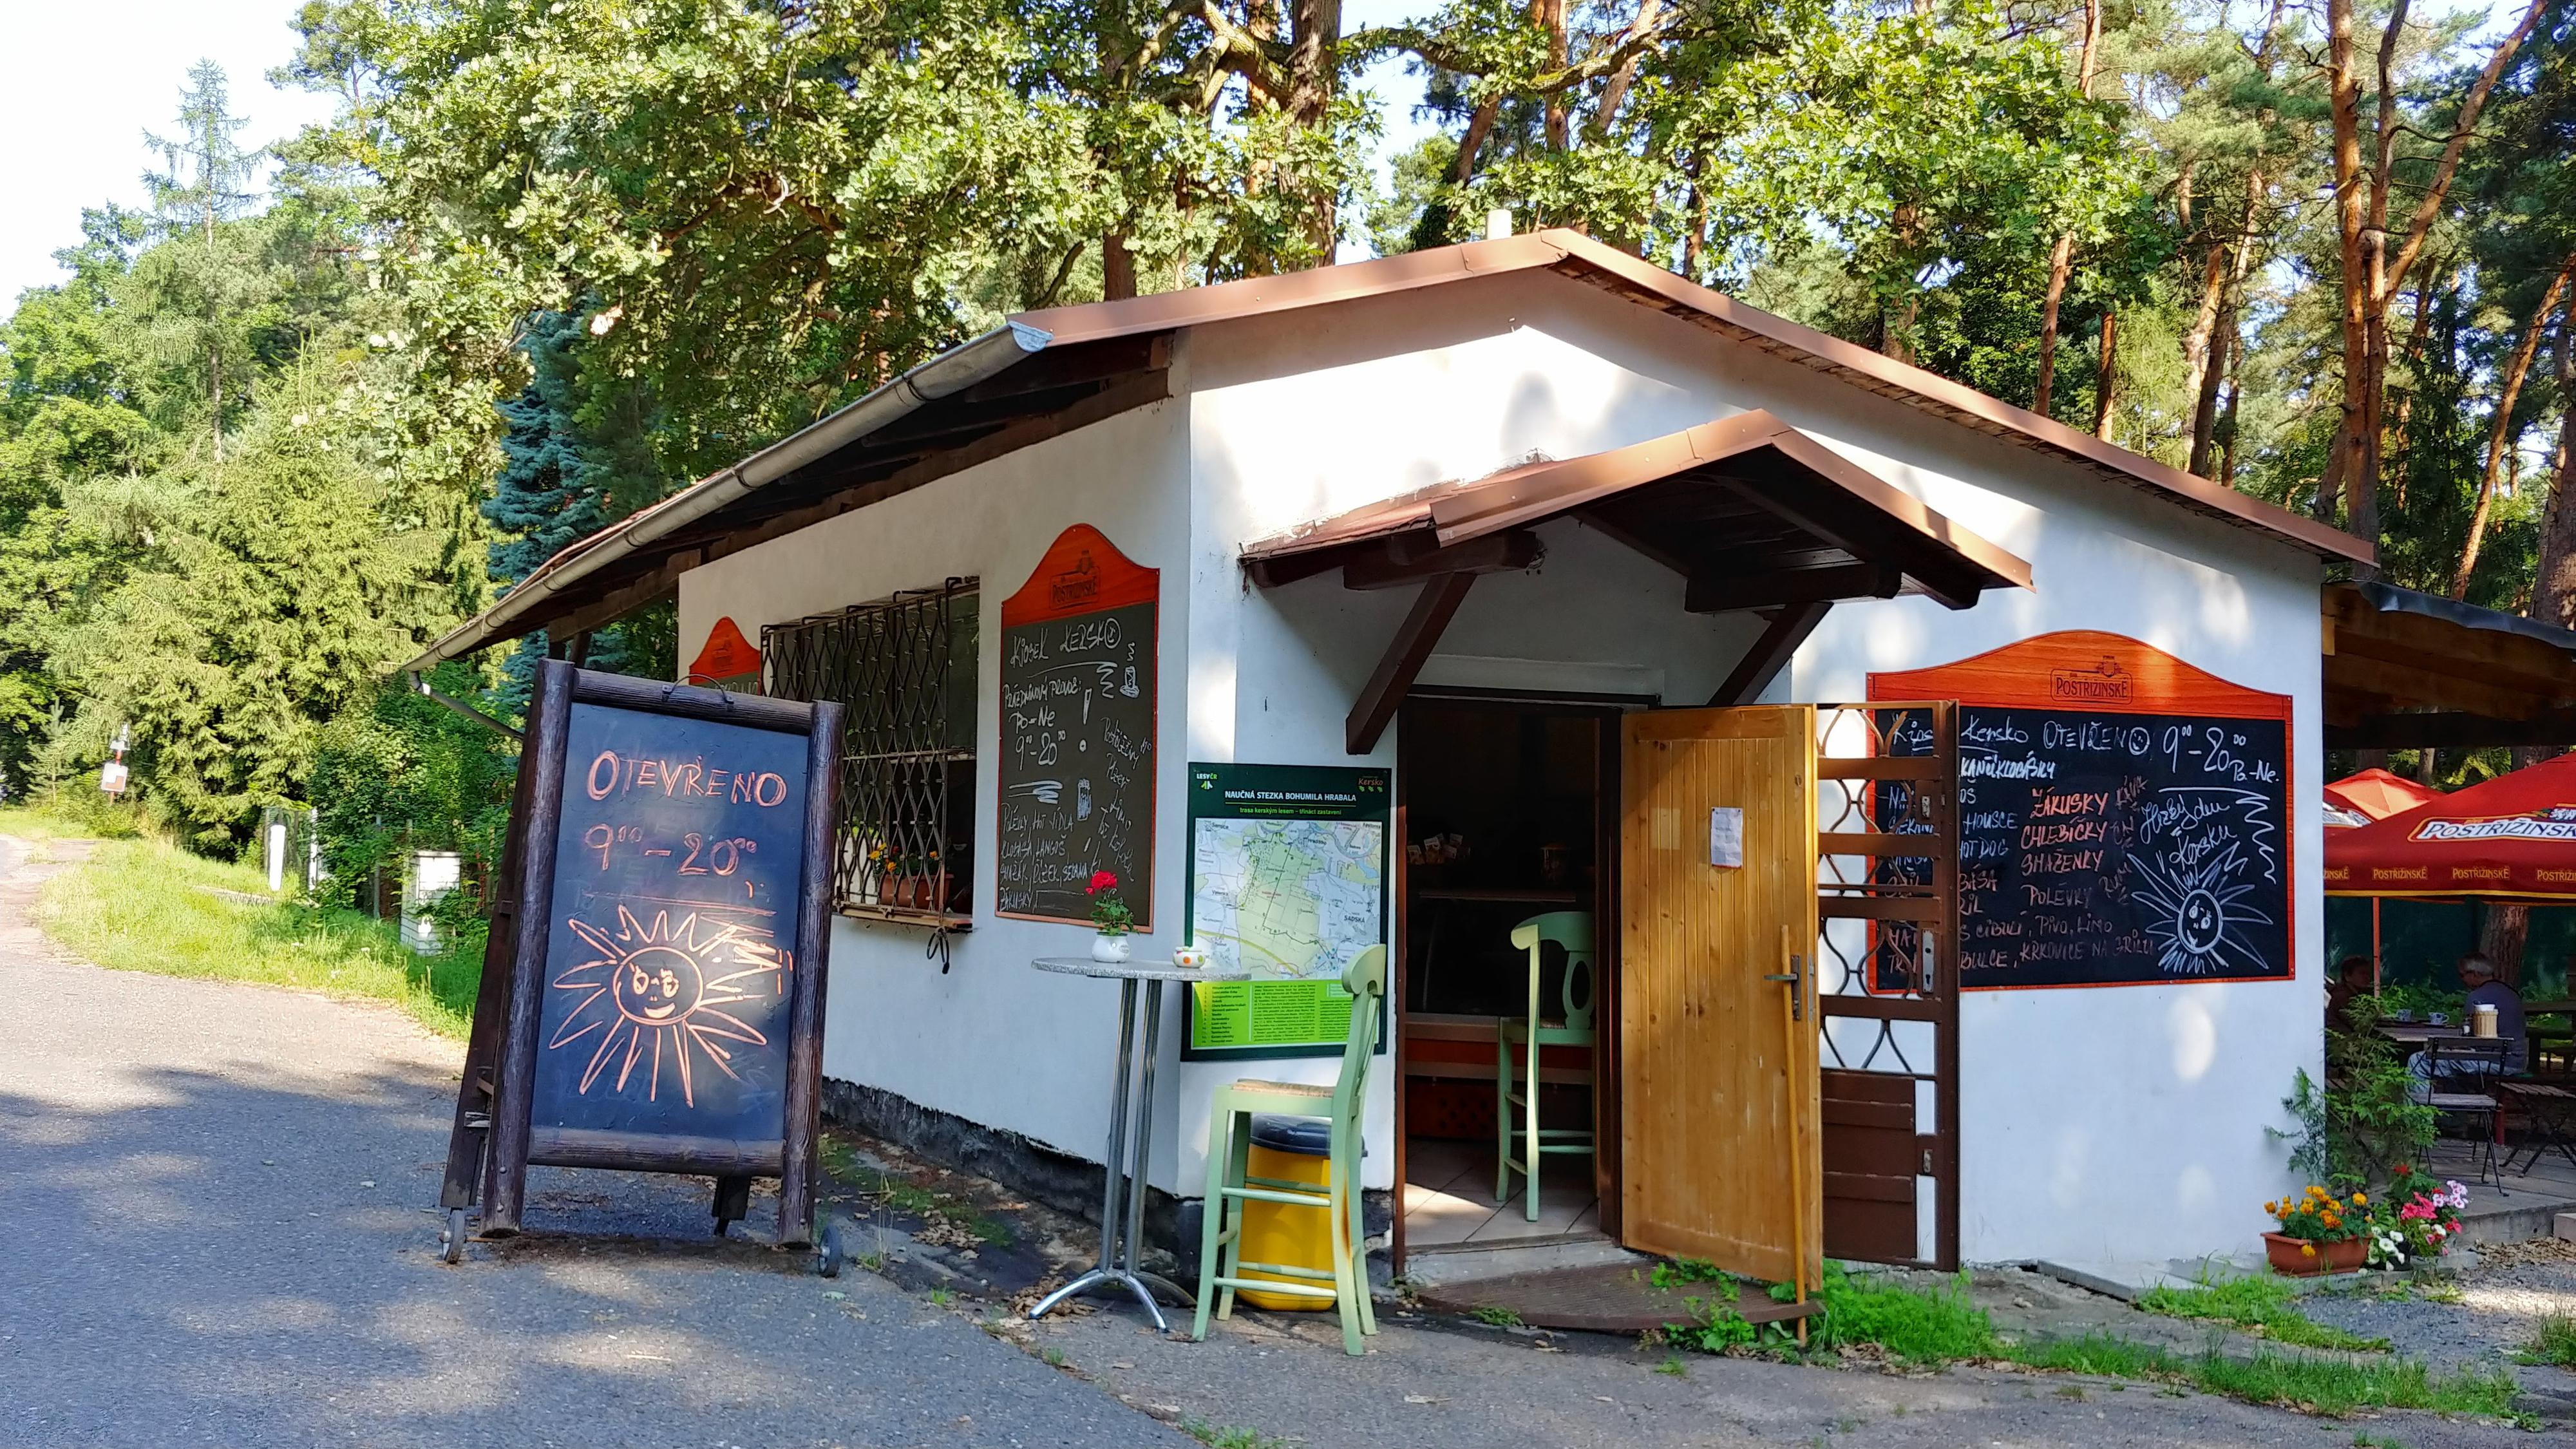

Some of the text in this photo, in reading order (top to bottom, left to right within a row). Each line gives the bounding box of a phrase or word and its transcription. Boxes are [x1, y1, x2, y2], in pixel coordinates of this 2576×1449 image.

[1010, 627, 1049, 668] KIOSEK
[1961, 714, 2029, 743] Kersko
[587, 750, 787, 806] OTEVŘENO
[1225, 790, 1255, 799] NAUČNÁ
[1256, 791, 1283, 800] STEZKA
[1285, 793, 1323, 801] BOHUMILA
[2030, 787, 2109, 819] ZÁKUSKY
[1255, 807, 1278, 815] kerským
[2020, 816, 2108, 849] CHLEBÍČKY
[2420, 817, 2576, 838] POSTŘIŽINSK
[1978, 836, 2009, 860] DOG
[2021, 849, 2104, 876] SMAŽENKY
[2324, 866, 2349, 880] ŽINSKÉ
[2373, 866, 2427, 880] POSTŘIŽINSKÉ
[2452, 866, 2510, 880] POSTŘIŽINSKÉ
